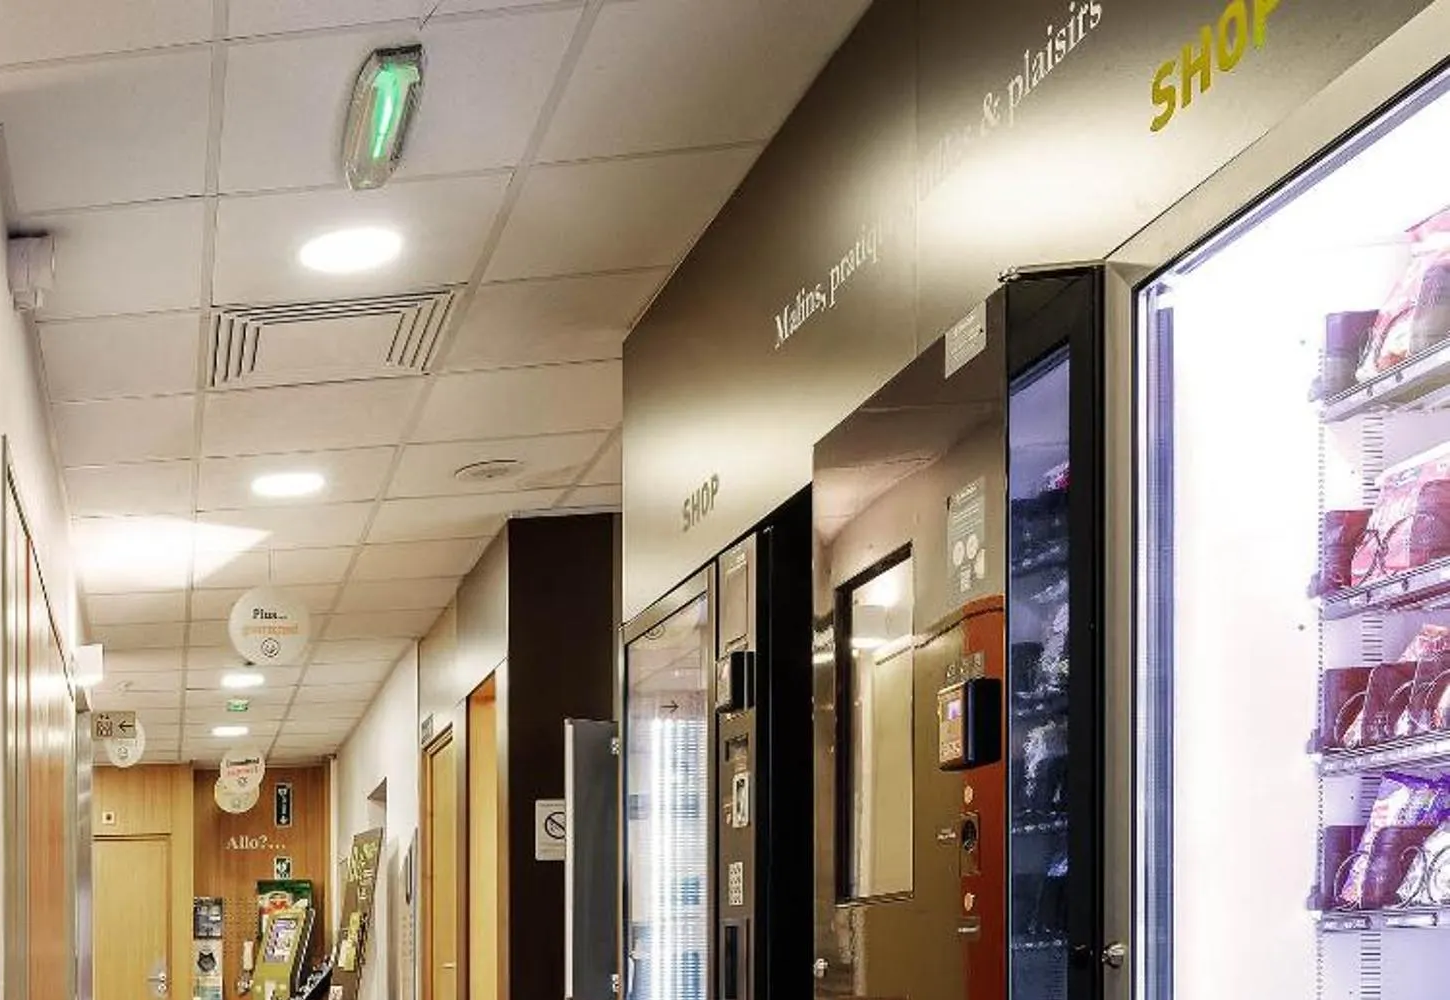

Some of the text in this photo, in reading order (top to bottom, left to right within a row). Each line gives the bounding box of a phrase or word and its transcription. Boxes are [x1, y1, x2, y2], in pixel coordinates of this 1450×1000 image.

[773, 283, 827, 350] Malins,
[1007, 0, 1102, 128] plaisirs
[682, 473, 720, 532] SHOP
